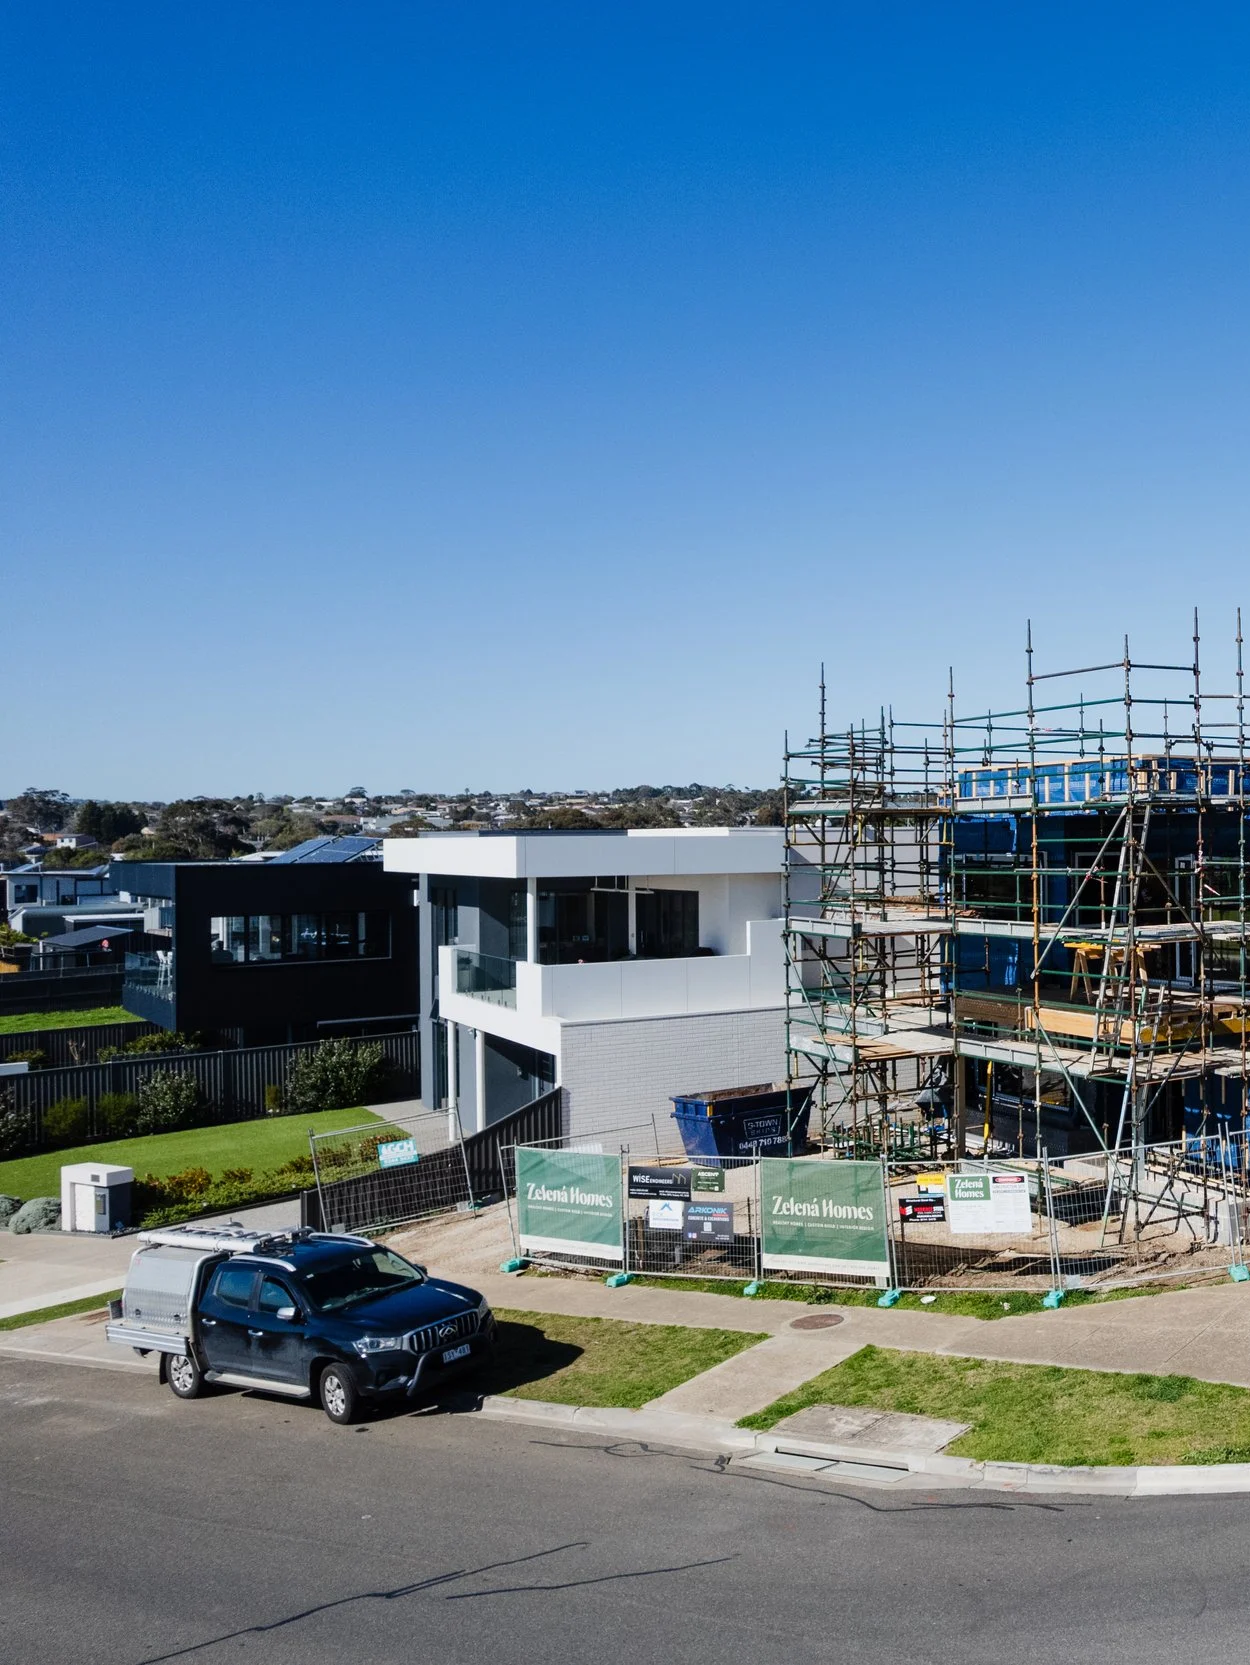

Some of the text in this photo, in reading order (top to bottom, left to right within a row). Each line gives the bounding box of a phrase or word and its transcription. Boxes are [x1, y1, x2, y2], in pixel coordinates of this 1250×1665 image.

[954, 1178, 984, 1189] Zelená
[526, 1182, 613, 1208] Zelená Homes
[954, 1189, 985, 1199] Homes
[688, 1206, 728, 1214] ARKONIK
[772, 1195, 874, 1221] Zelená Homes
